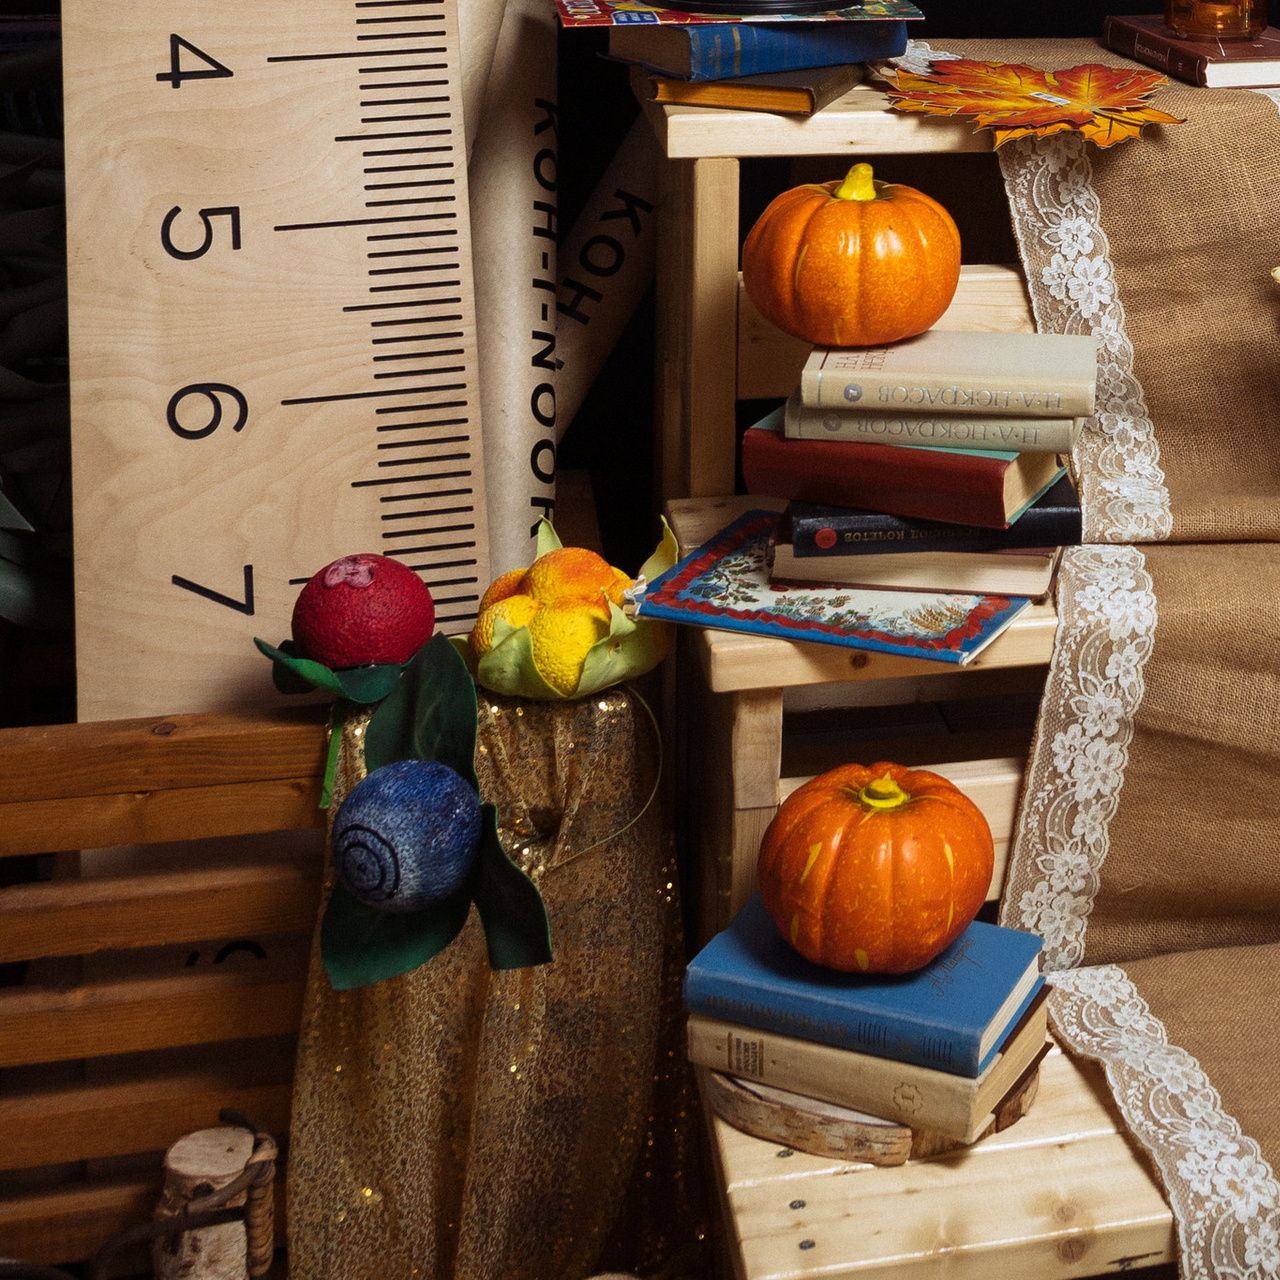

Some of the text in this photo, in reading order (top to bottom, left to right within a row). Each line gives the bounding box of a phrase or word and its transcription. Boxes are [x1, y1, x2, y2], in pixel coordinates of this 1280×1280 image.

[156, 33, 234, 89] 4
[161, 205, 241, 260] 5
[166, 383, 249, 439] 6
[172, 564, 255, 615] 7
